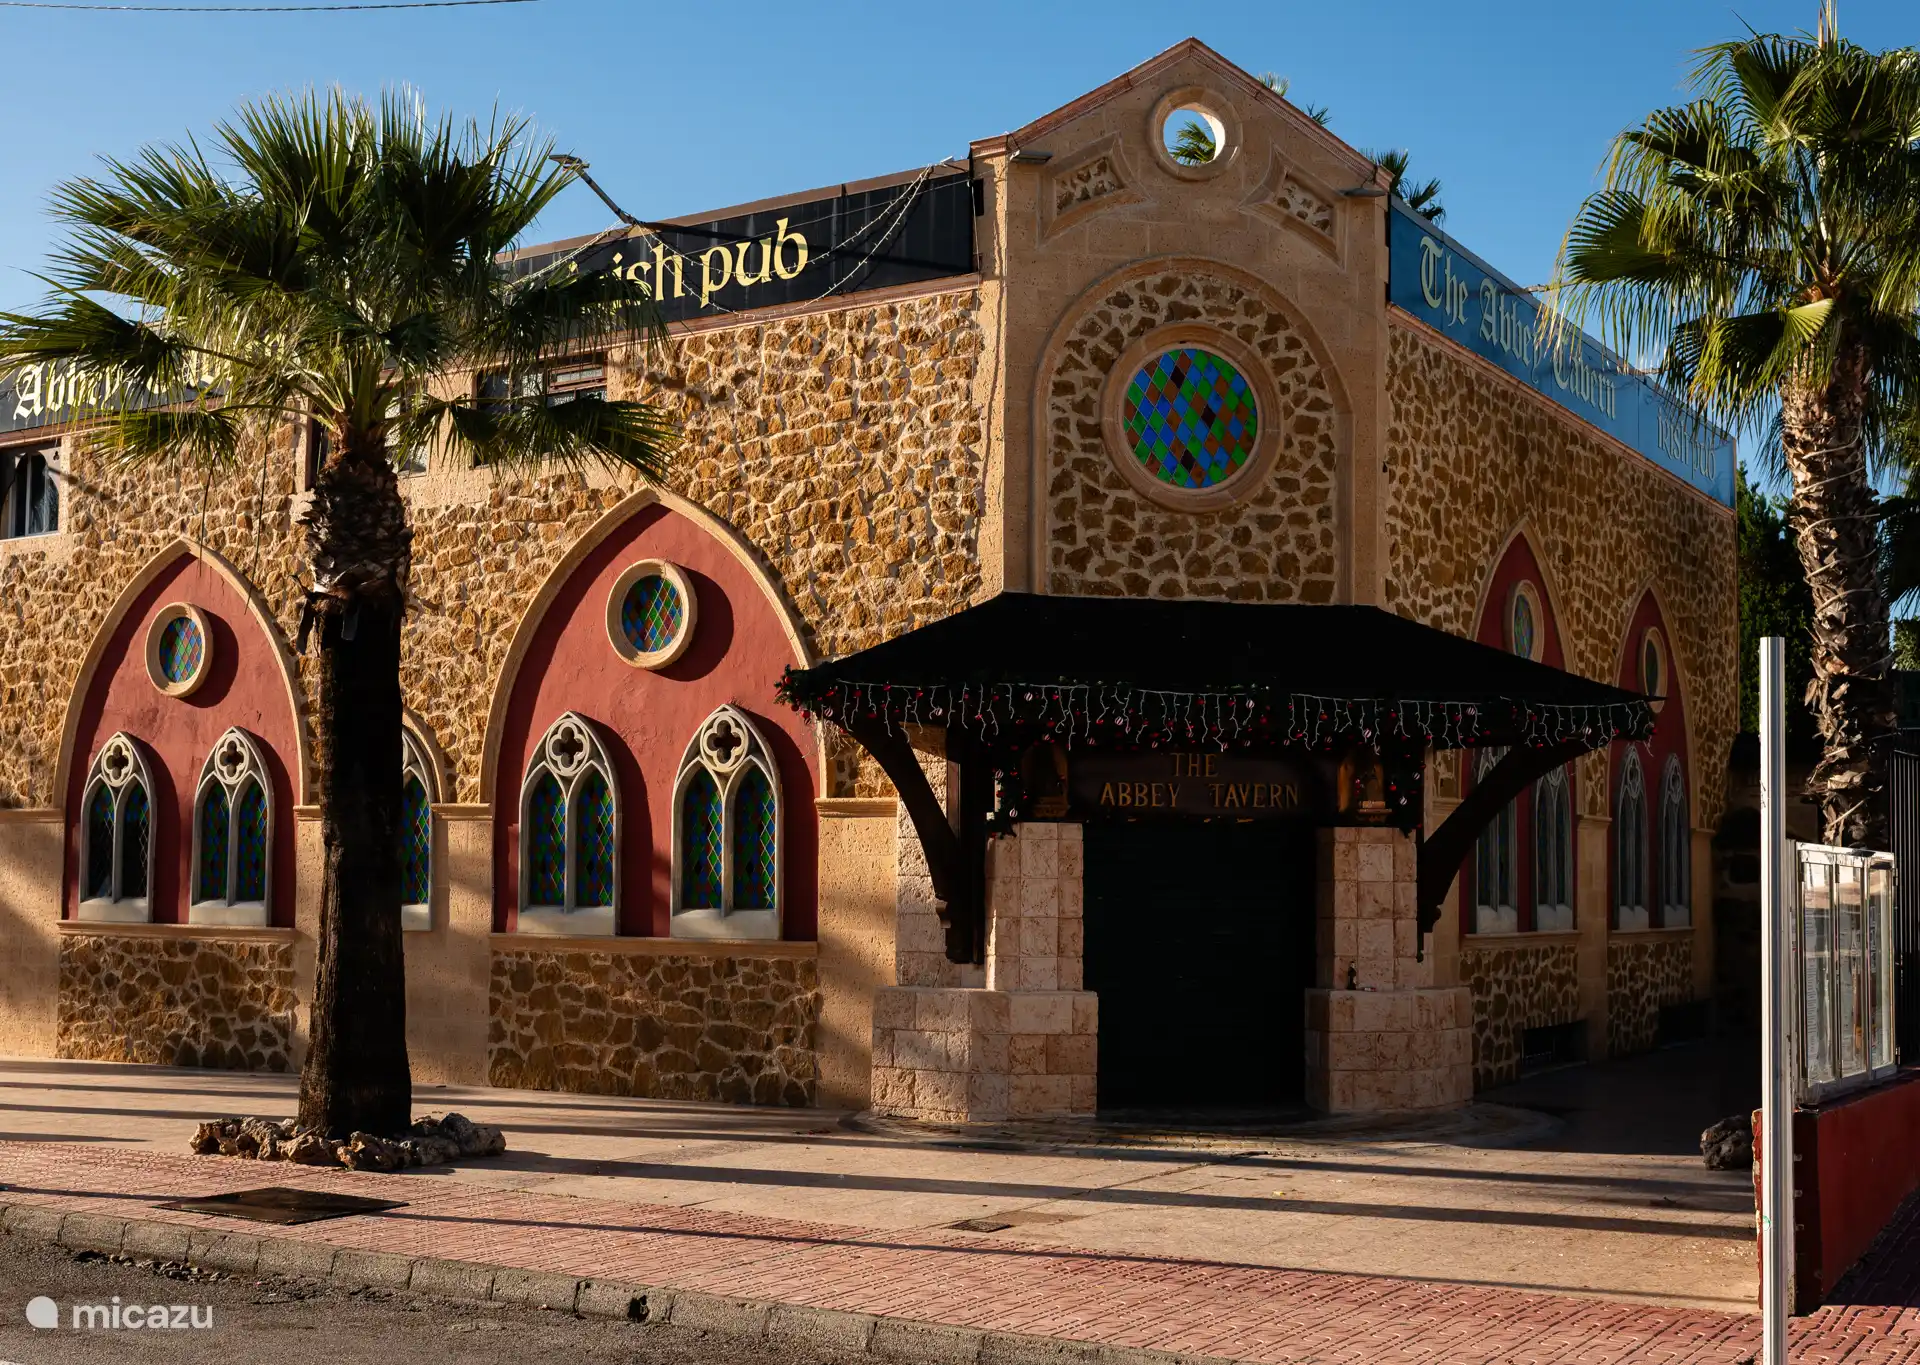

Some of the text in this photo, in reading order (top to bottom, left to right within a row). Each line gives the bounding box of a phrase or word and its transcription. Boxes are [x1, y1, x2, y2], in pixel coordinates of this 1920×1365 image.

[699, 217, 809, 309] pub
[1419, 236, 1469, 327] The
[1480, 278, 1543, 384] Abbey
[1099, 781, 1301, 809] ABBEY TAVERN
[1170, 752, 1219, 778] THE
